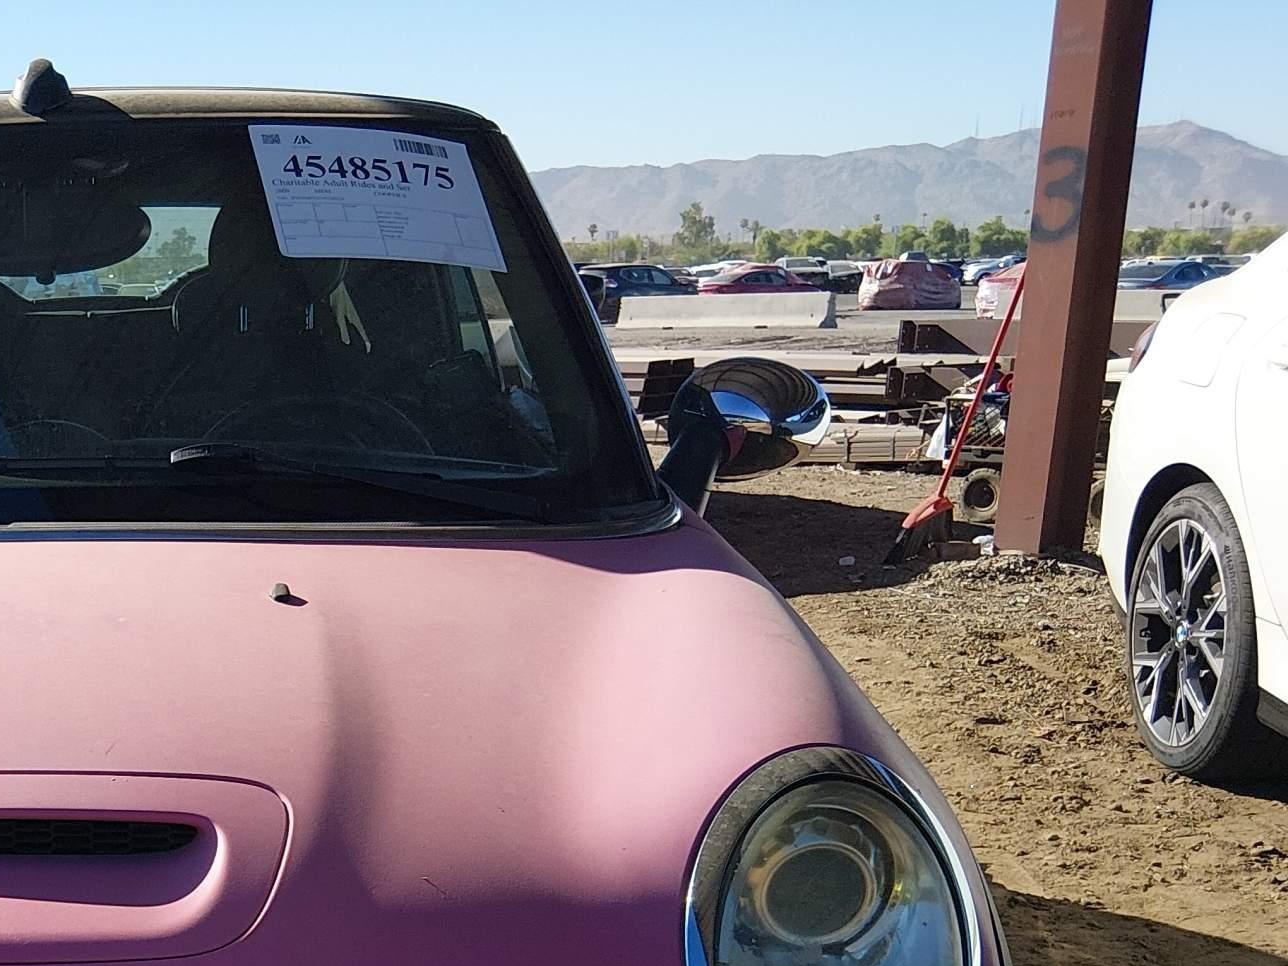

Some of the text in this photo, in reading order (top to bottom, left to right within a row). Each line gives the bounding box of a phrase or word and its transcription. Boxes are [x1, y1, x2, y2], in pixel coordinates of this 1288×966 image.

[272, 178, 319, 187] Charitable
[323, 179, 347, 188] Adult
[350, 180, 376, 189] Rides
[283, 154, 454, 190] 45485175
[1031, 146, 1088, 243] 3
